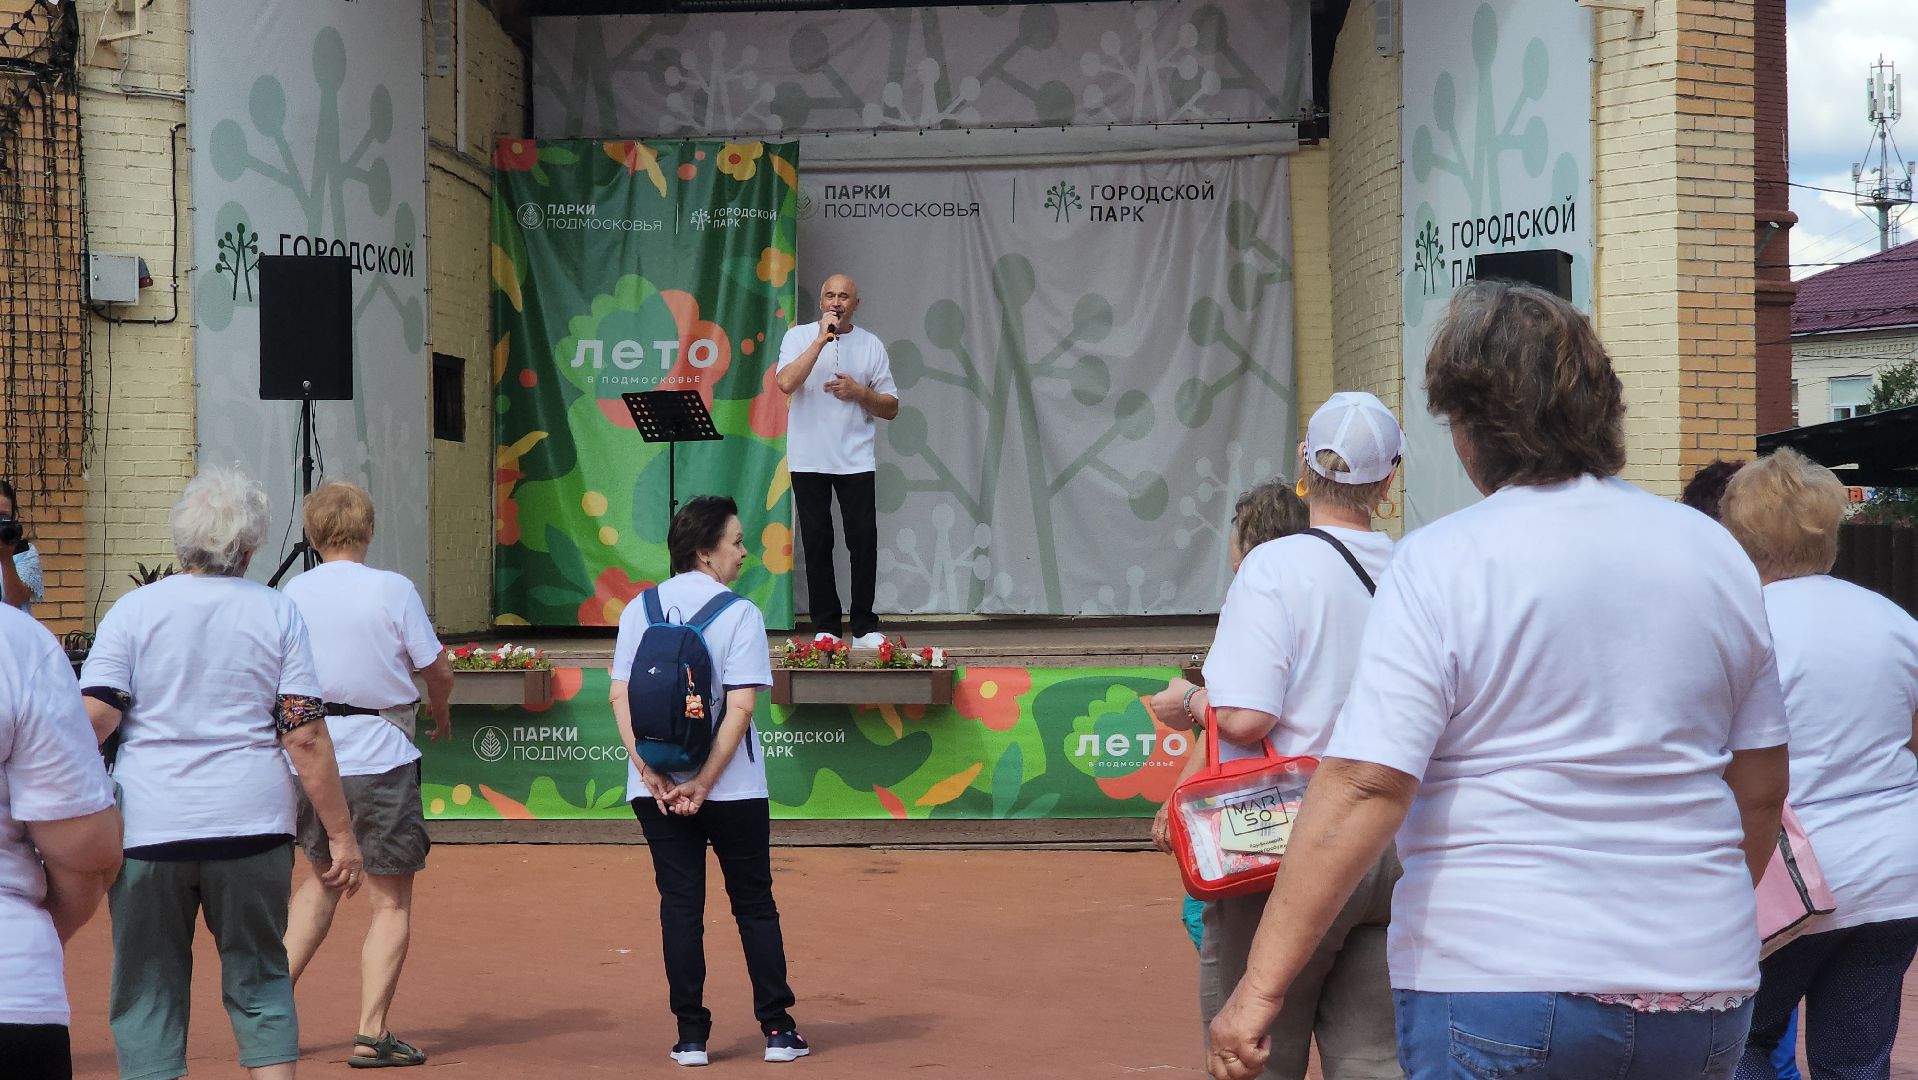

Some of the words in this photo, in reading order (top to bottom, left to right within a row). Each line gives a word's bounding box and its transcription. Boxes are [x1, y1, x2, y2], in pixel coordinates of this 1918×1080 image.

[825, 184, 890, 200] ПАРКИ
[1090, 180, 1215, 204] ГОРОДСКОЙ
[546, 203, 596, 216] ПАРКИ
[713, 207, 777, 221] ГОРОДСКОЙ
[824, 202, 980, 218] ПОДМОСКОВЬЯ
[1090, 205, 1144, 222] ПАРК
[546, 217, 662, 231] ПОДМОСКОВЬЯ
[713, 218, 741, 229] ПАРК
[1451, 194, 1575, 250] ГОРОДСКОЙ
[279, 233, 414, 277] ГОРОДСКОЙ
[1451, 257, 1475, 288] ПА
[570, 338, 719, 370] лето
[513, 726, 578, 742] ПАРКИ
[513, 745, 629, 761] ПОДМОСКО
[1074, 733, 1188, 757] лето
[1232, 795, 1276, 815] MAR
[1244, 809, 1272, 827] SO
